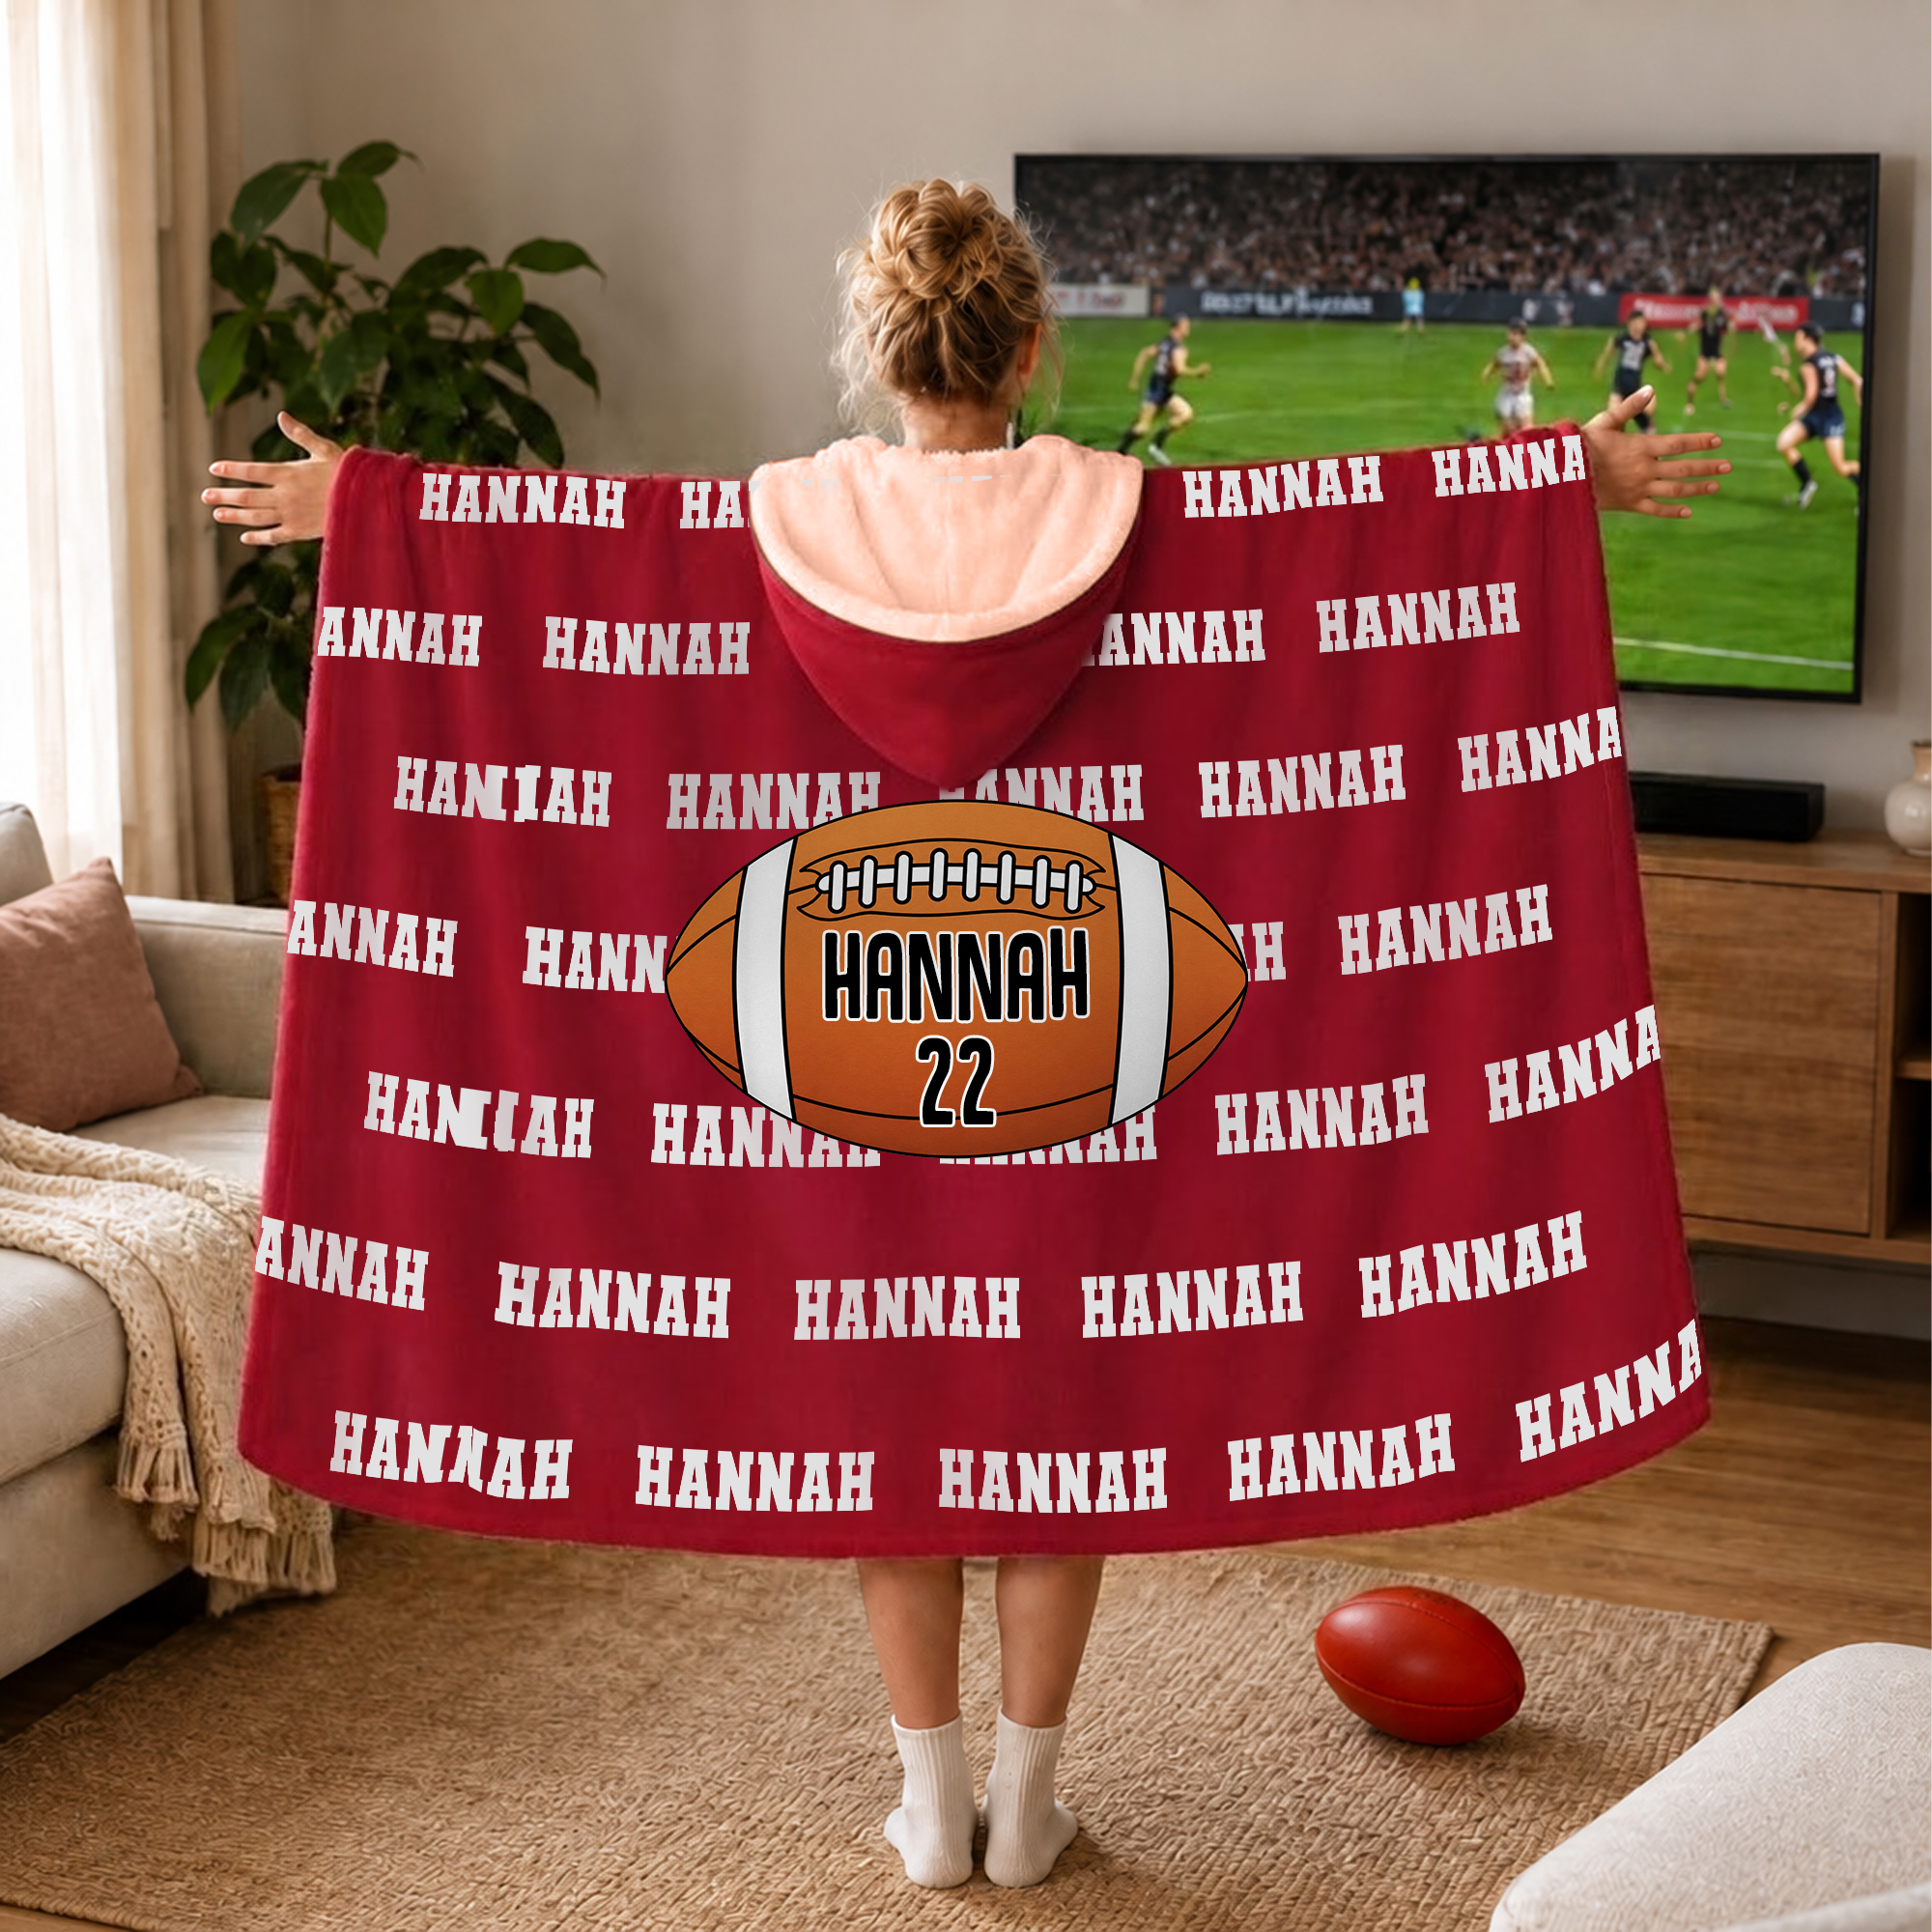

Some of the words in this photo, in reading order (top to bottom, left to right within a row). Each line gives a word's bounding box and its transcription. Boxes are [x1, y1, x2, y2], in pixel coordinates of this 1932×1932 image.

[419, 473, 626, 528] HANNAH
[680, 481, 751, 529] HA
[1182, 458, 1383, 518] HANNAH
[543, 616, 750, 674] HANNAH
[1317, 582, 1520, 652] HANNAH
[667, 772, 880, 829] HANNAH
[939, 764, 1145, 823] ANNAH
[1199, 745, 1406, 817] HANNAH
[822, 927, 1091, 1024] HANNAH
[1338, 884, 1552, 975] HANNAH
[915, 1035, 997, 1128] 22
[1215, 1074, 1429, 1155] HANNAH
[495, 1262, 730, 1338] HANNAH
[794, 1276, 1020, 1340] HANNAH
[1082, 1262, 1303, 1338] HANNAH
[1359, 1210, 1587, 1318] HANNAH
[330, 1410, 573, 1499] HANNAH
[636, 1445, 874, 1512] HANNAH
[939, 1448, 1167, 1513] HANNAH
[1228, 1413, 1455, 1501] HANNAH
